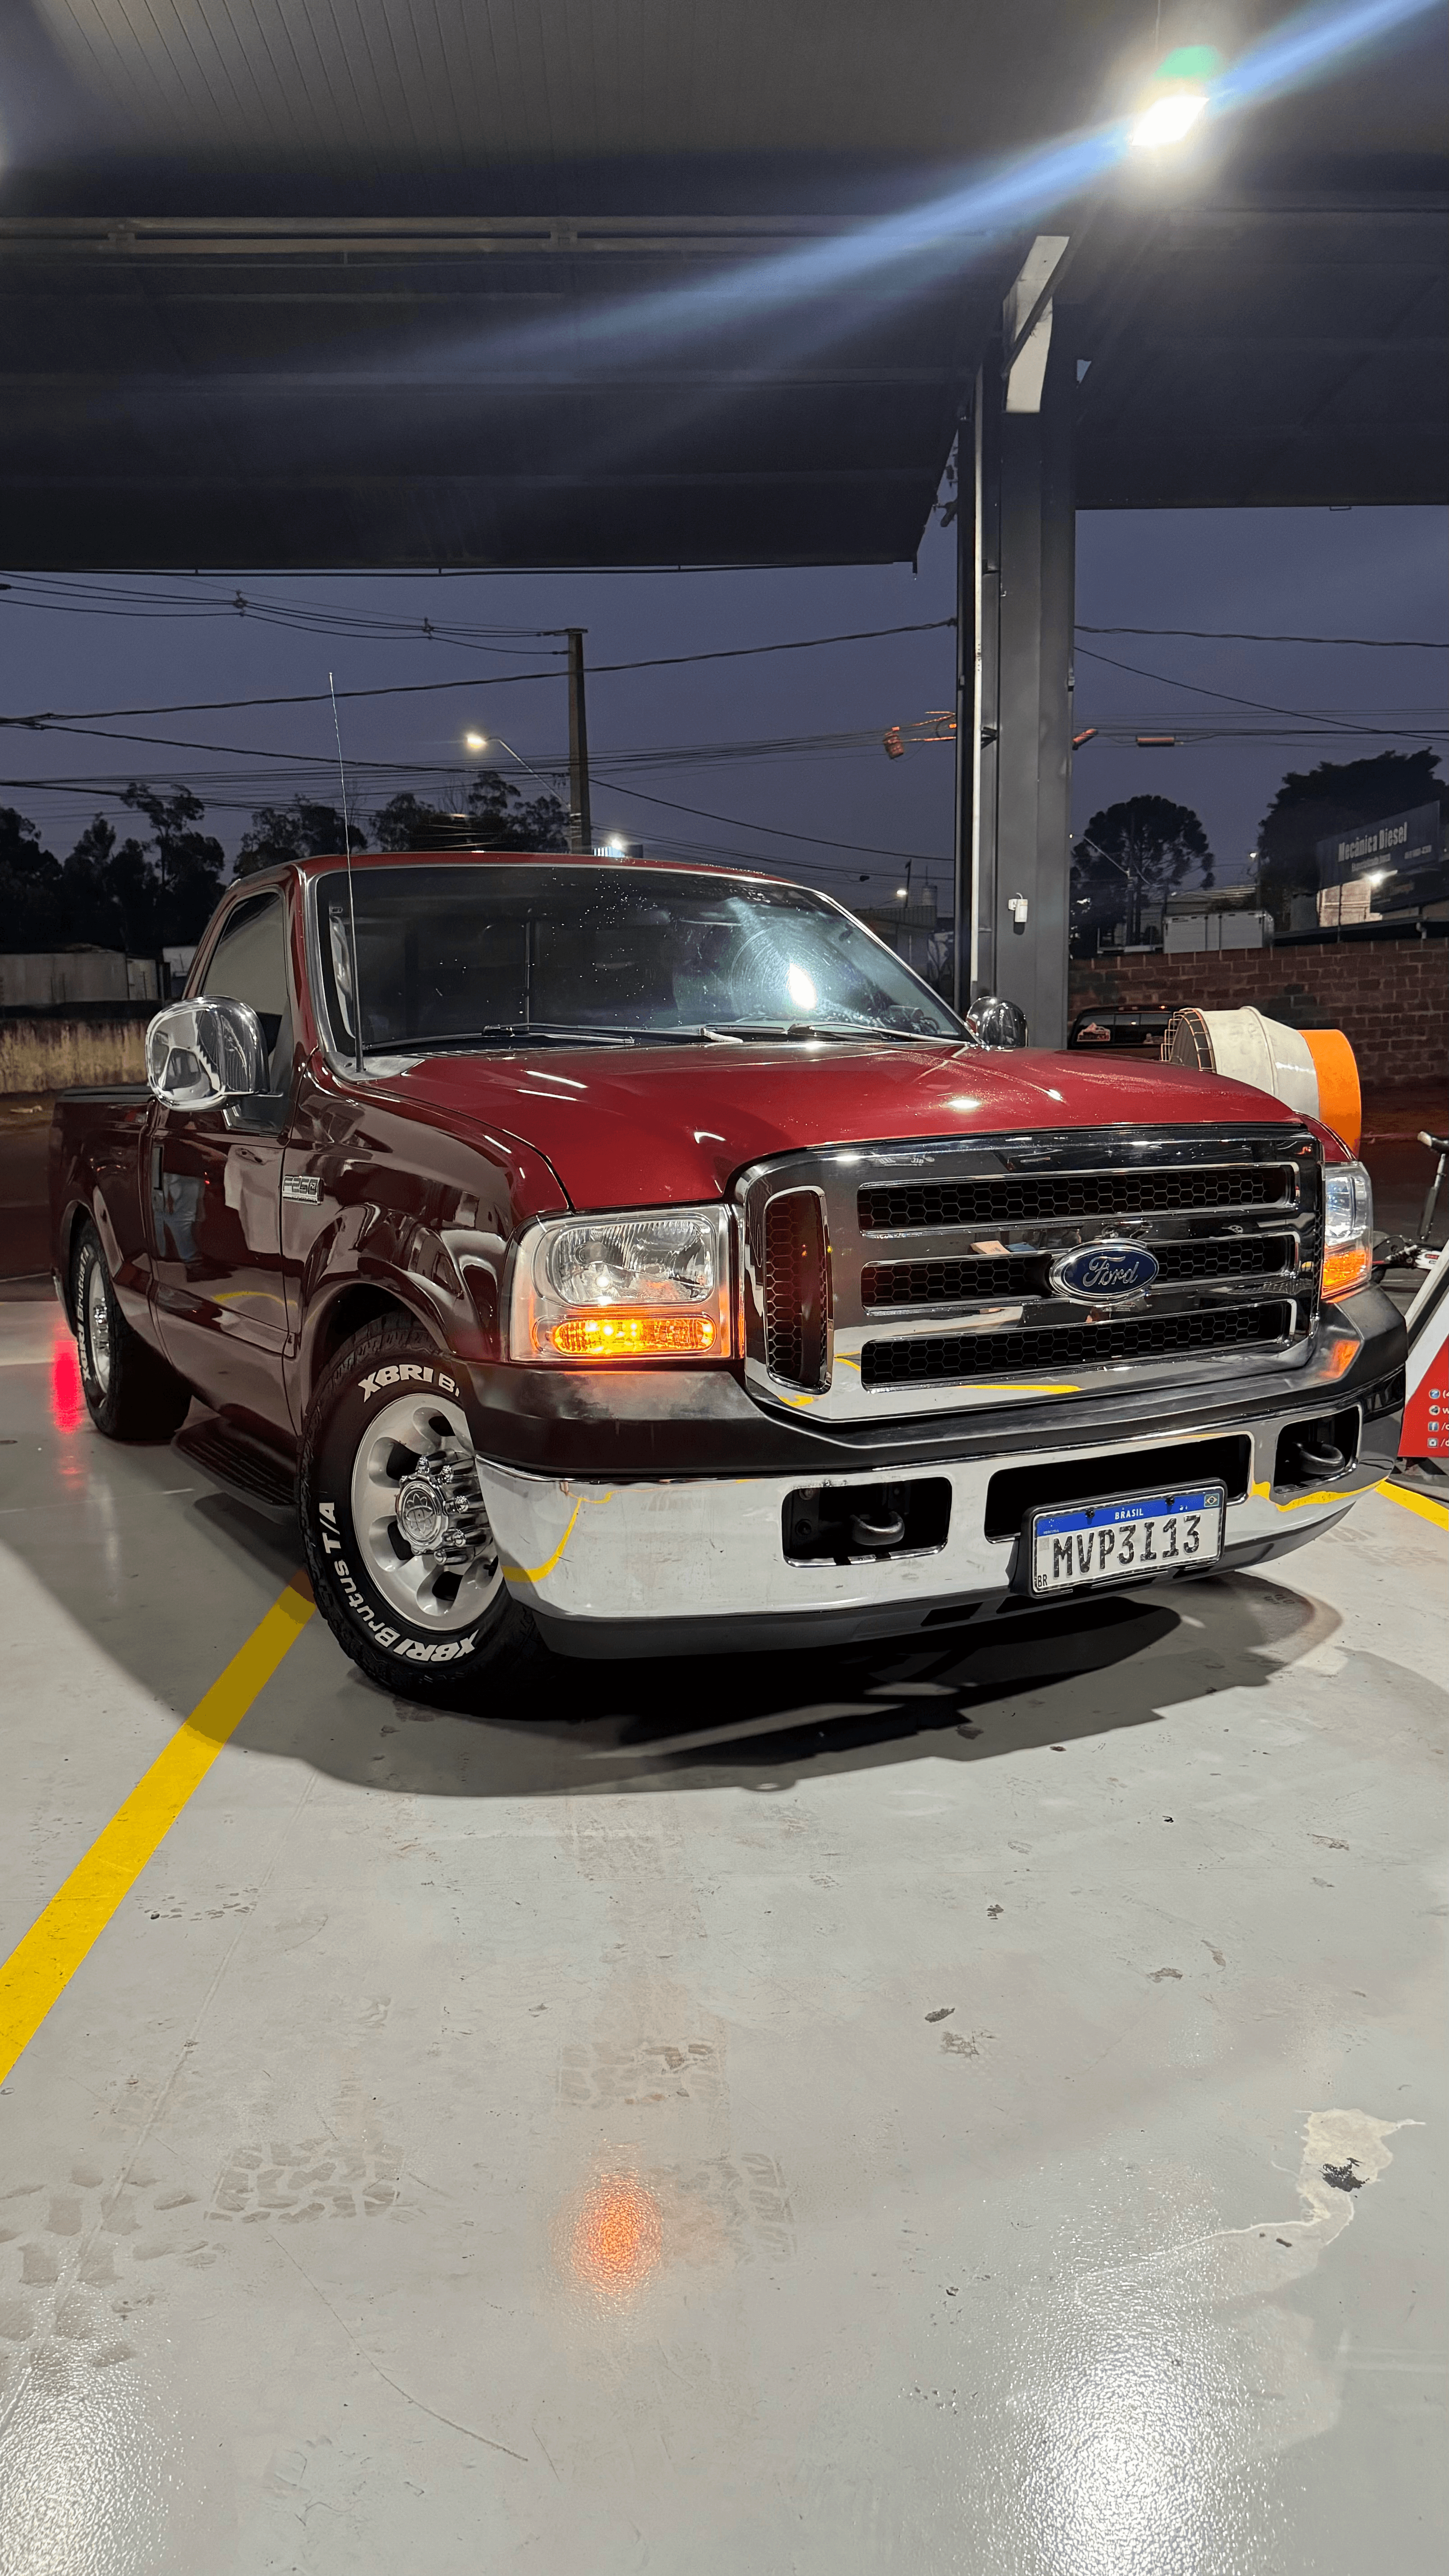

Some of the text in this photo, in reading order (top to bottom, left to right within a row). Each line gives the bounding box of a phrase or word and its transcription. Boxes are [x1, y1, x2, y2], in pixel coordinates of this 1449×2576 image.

[1338, 835, 1377, 862] Mecânica
[1379, 821, 1408, 850] Diesel
[1083, 1256, 1139, 1287] Ford
[358, 1364, 433, 1403] XBRI
[1115, 1508, 1144, 1520] BRASIL
[1053, 1513, 1201, 1578] MVP3I13
[319, 1503, 479, 1661] XBRI Brutus T/A
[1038, 1574, 1047, 1587] BR
